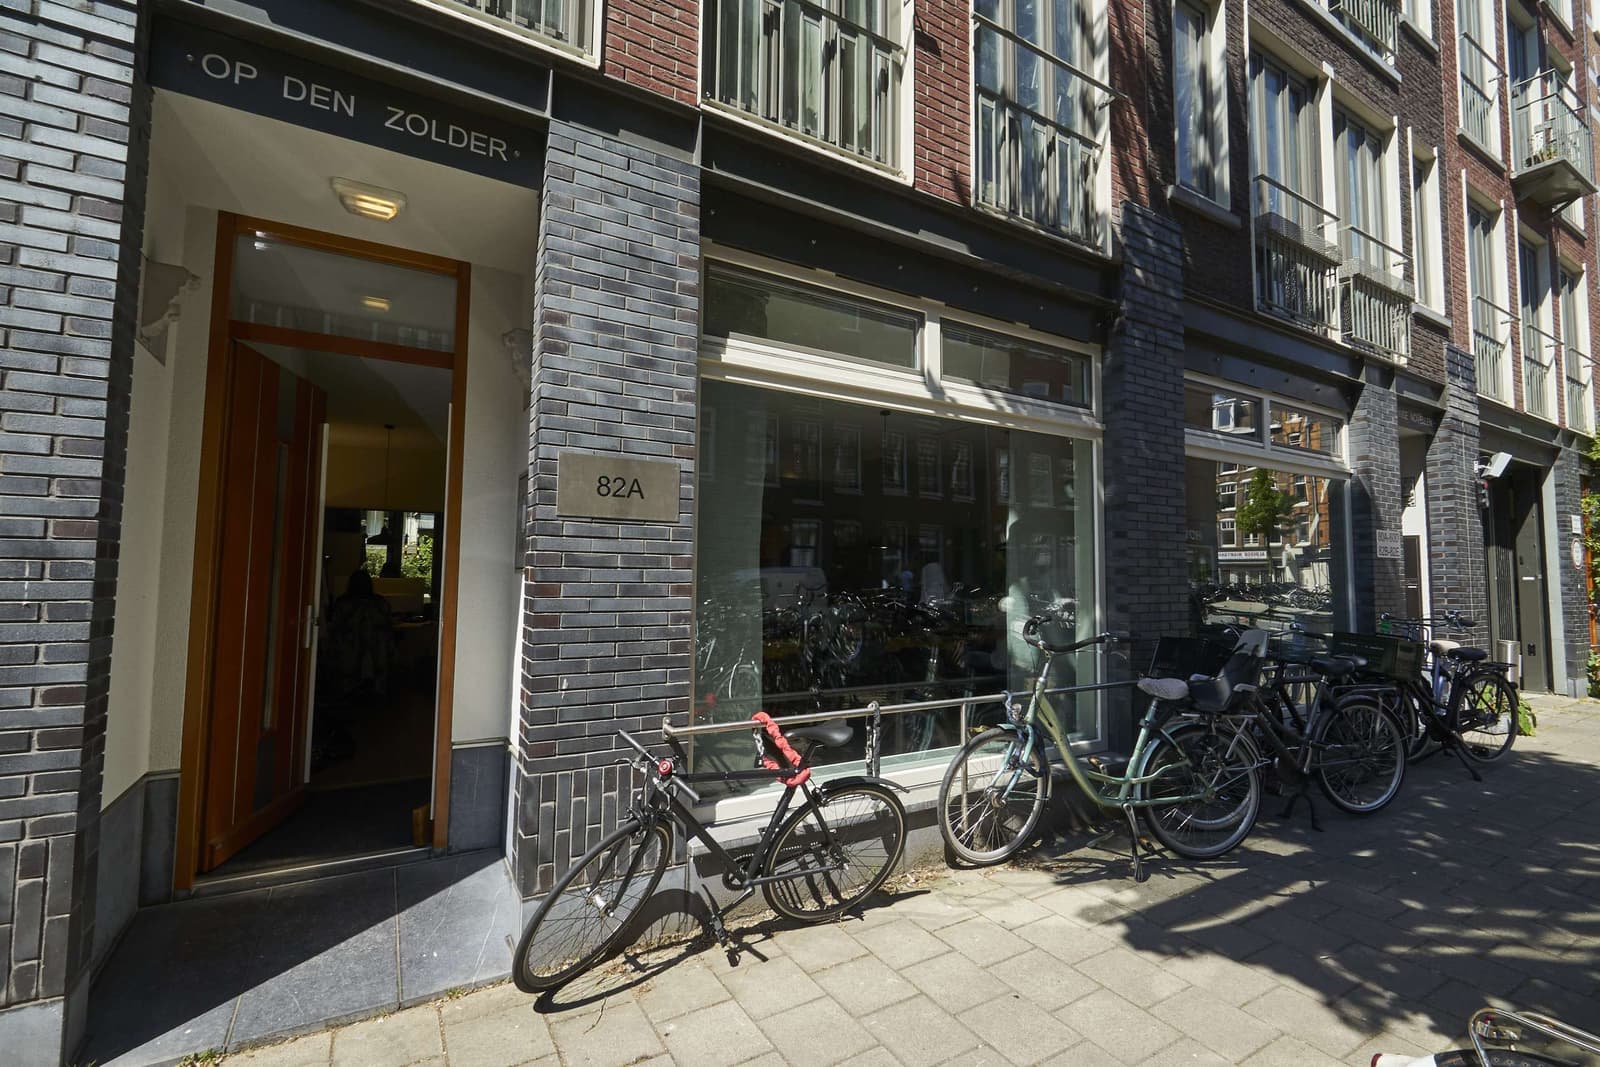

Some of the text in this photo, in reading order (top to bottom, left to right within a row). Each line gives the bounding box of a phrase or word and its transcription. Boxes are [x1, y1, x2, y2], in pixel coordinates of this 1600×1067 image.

[202, 54, 508, 161] OP DEN ZOLDER
[596, 475, 645, 500] 82A
